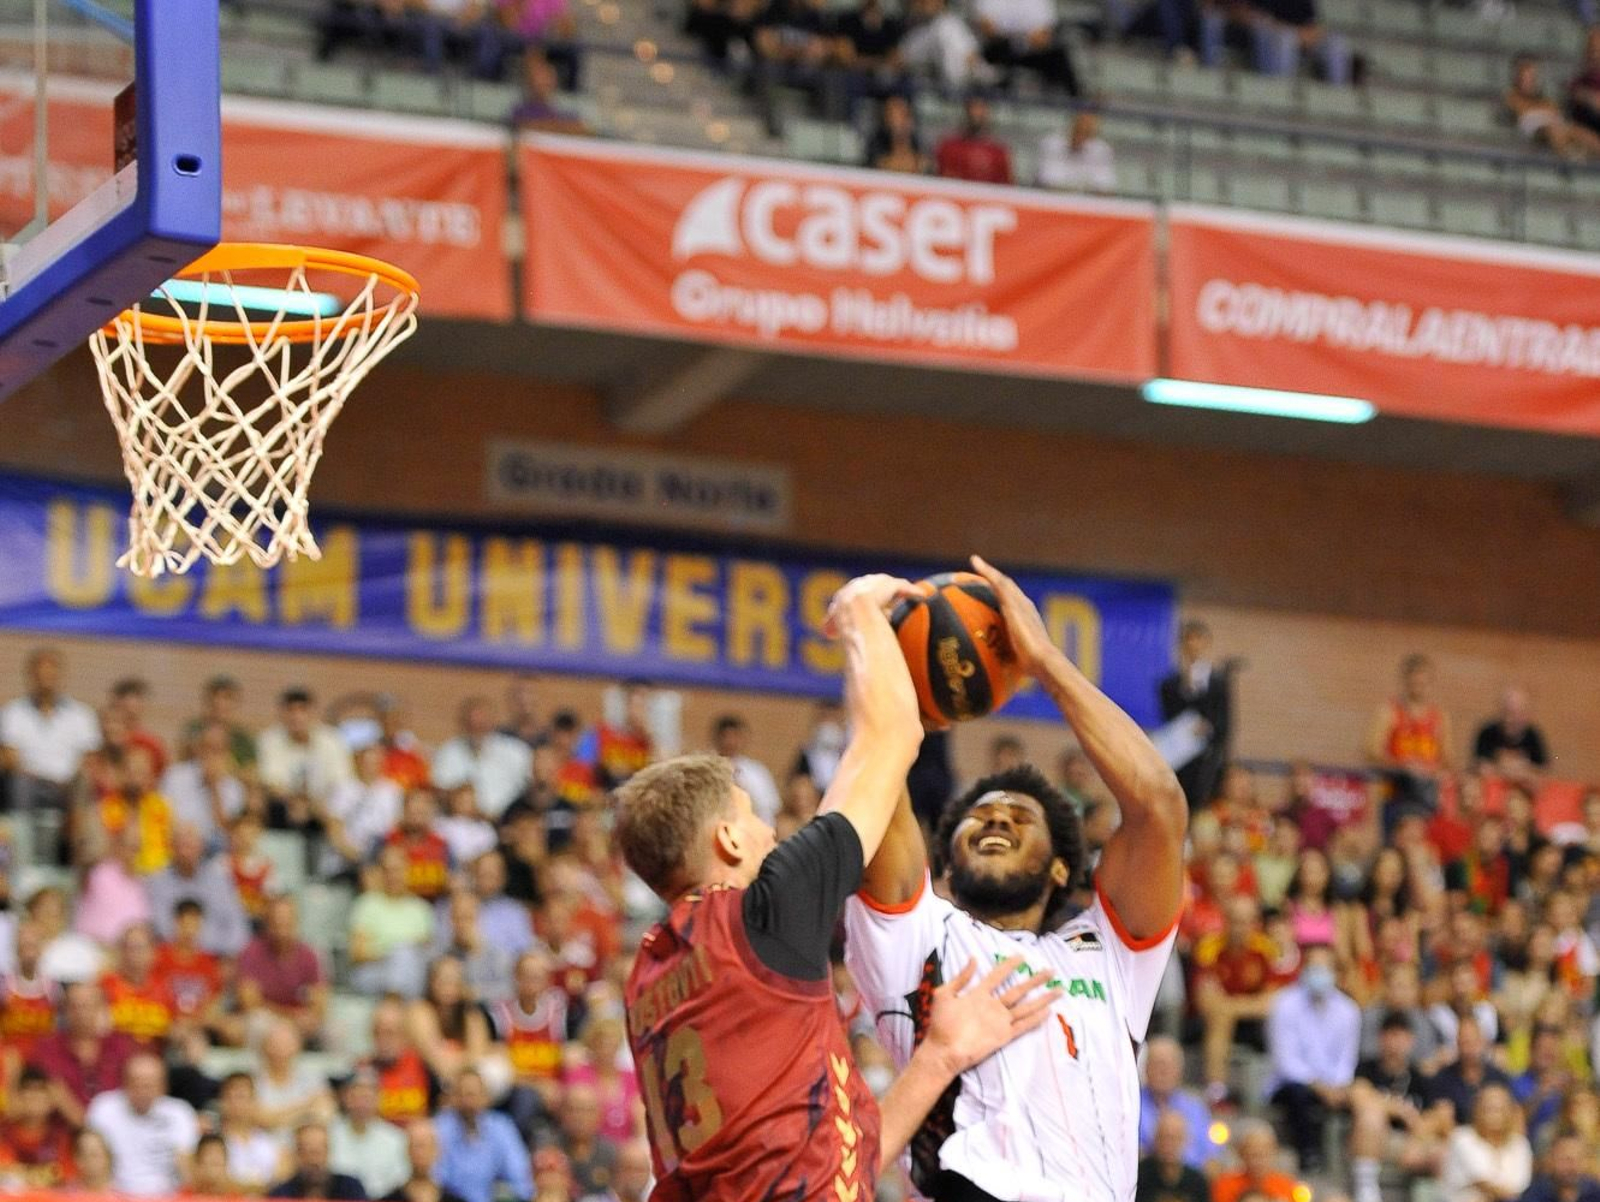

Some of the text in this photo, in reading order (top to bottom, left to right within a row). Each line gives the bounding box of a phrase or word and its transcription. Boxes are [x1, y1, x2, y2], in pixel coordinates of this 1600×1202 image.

[742, 178, 1019, 286] caser
[670, 268, 828, 341] Grupo
[45, 498, 359, 635] UCAM
[405, 530, 1100, 690] UNIVERSD
[641, 1022, 723, 1175] 13
